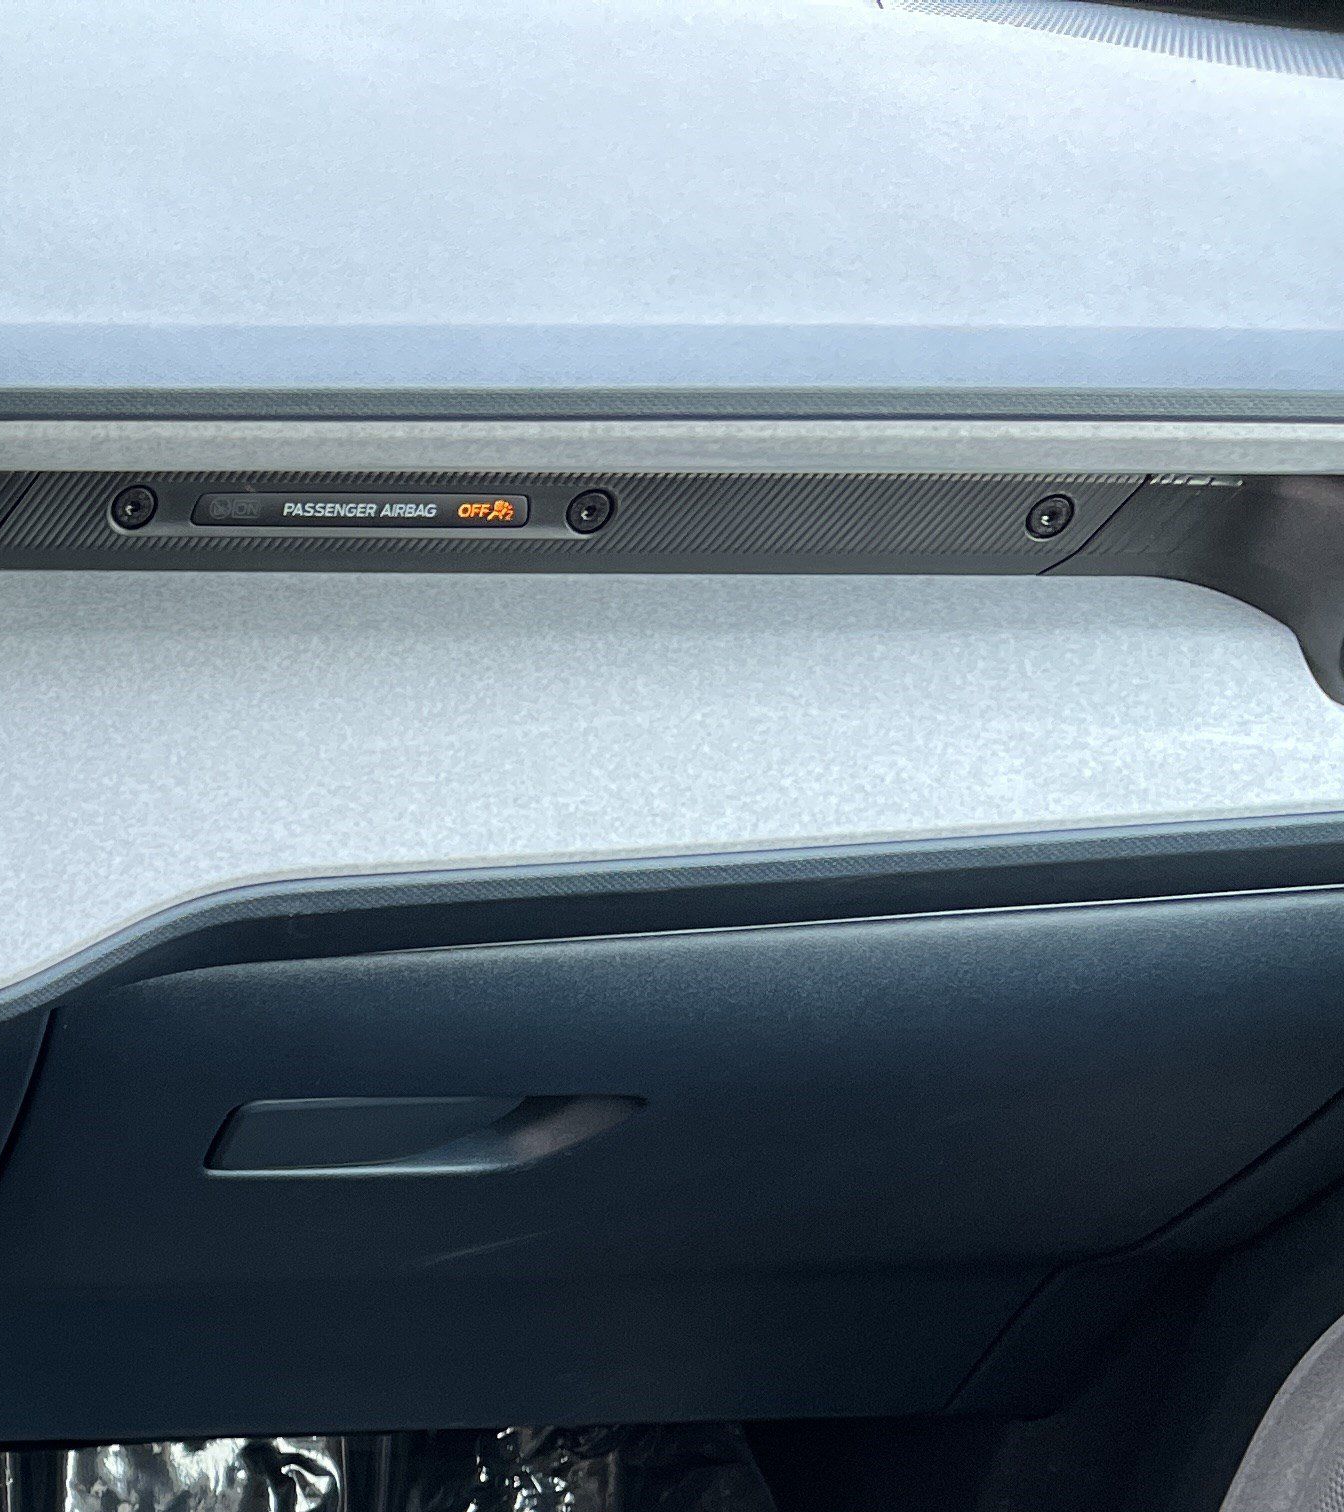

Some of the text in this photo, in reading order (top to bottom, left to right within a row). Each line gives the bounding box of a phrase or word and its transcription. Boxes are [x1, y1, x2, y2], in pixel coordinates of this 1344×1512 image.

[283, 503, 490, 518] PASSENGER AIRBAG OFF
